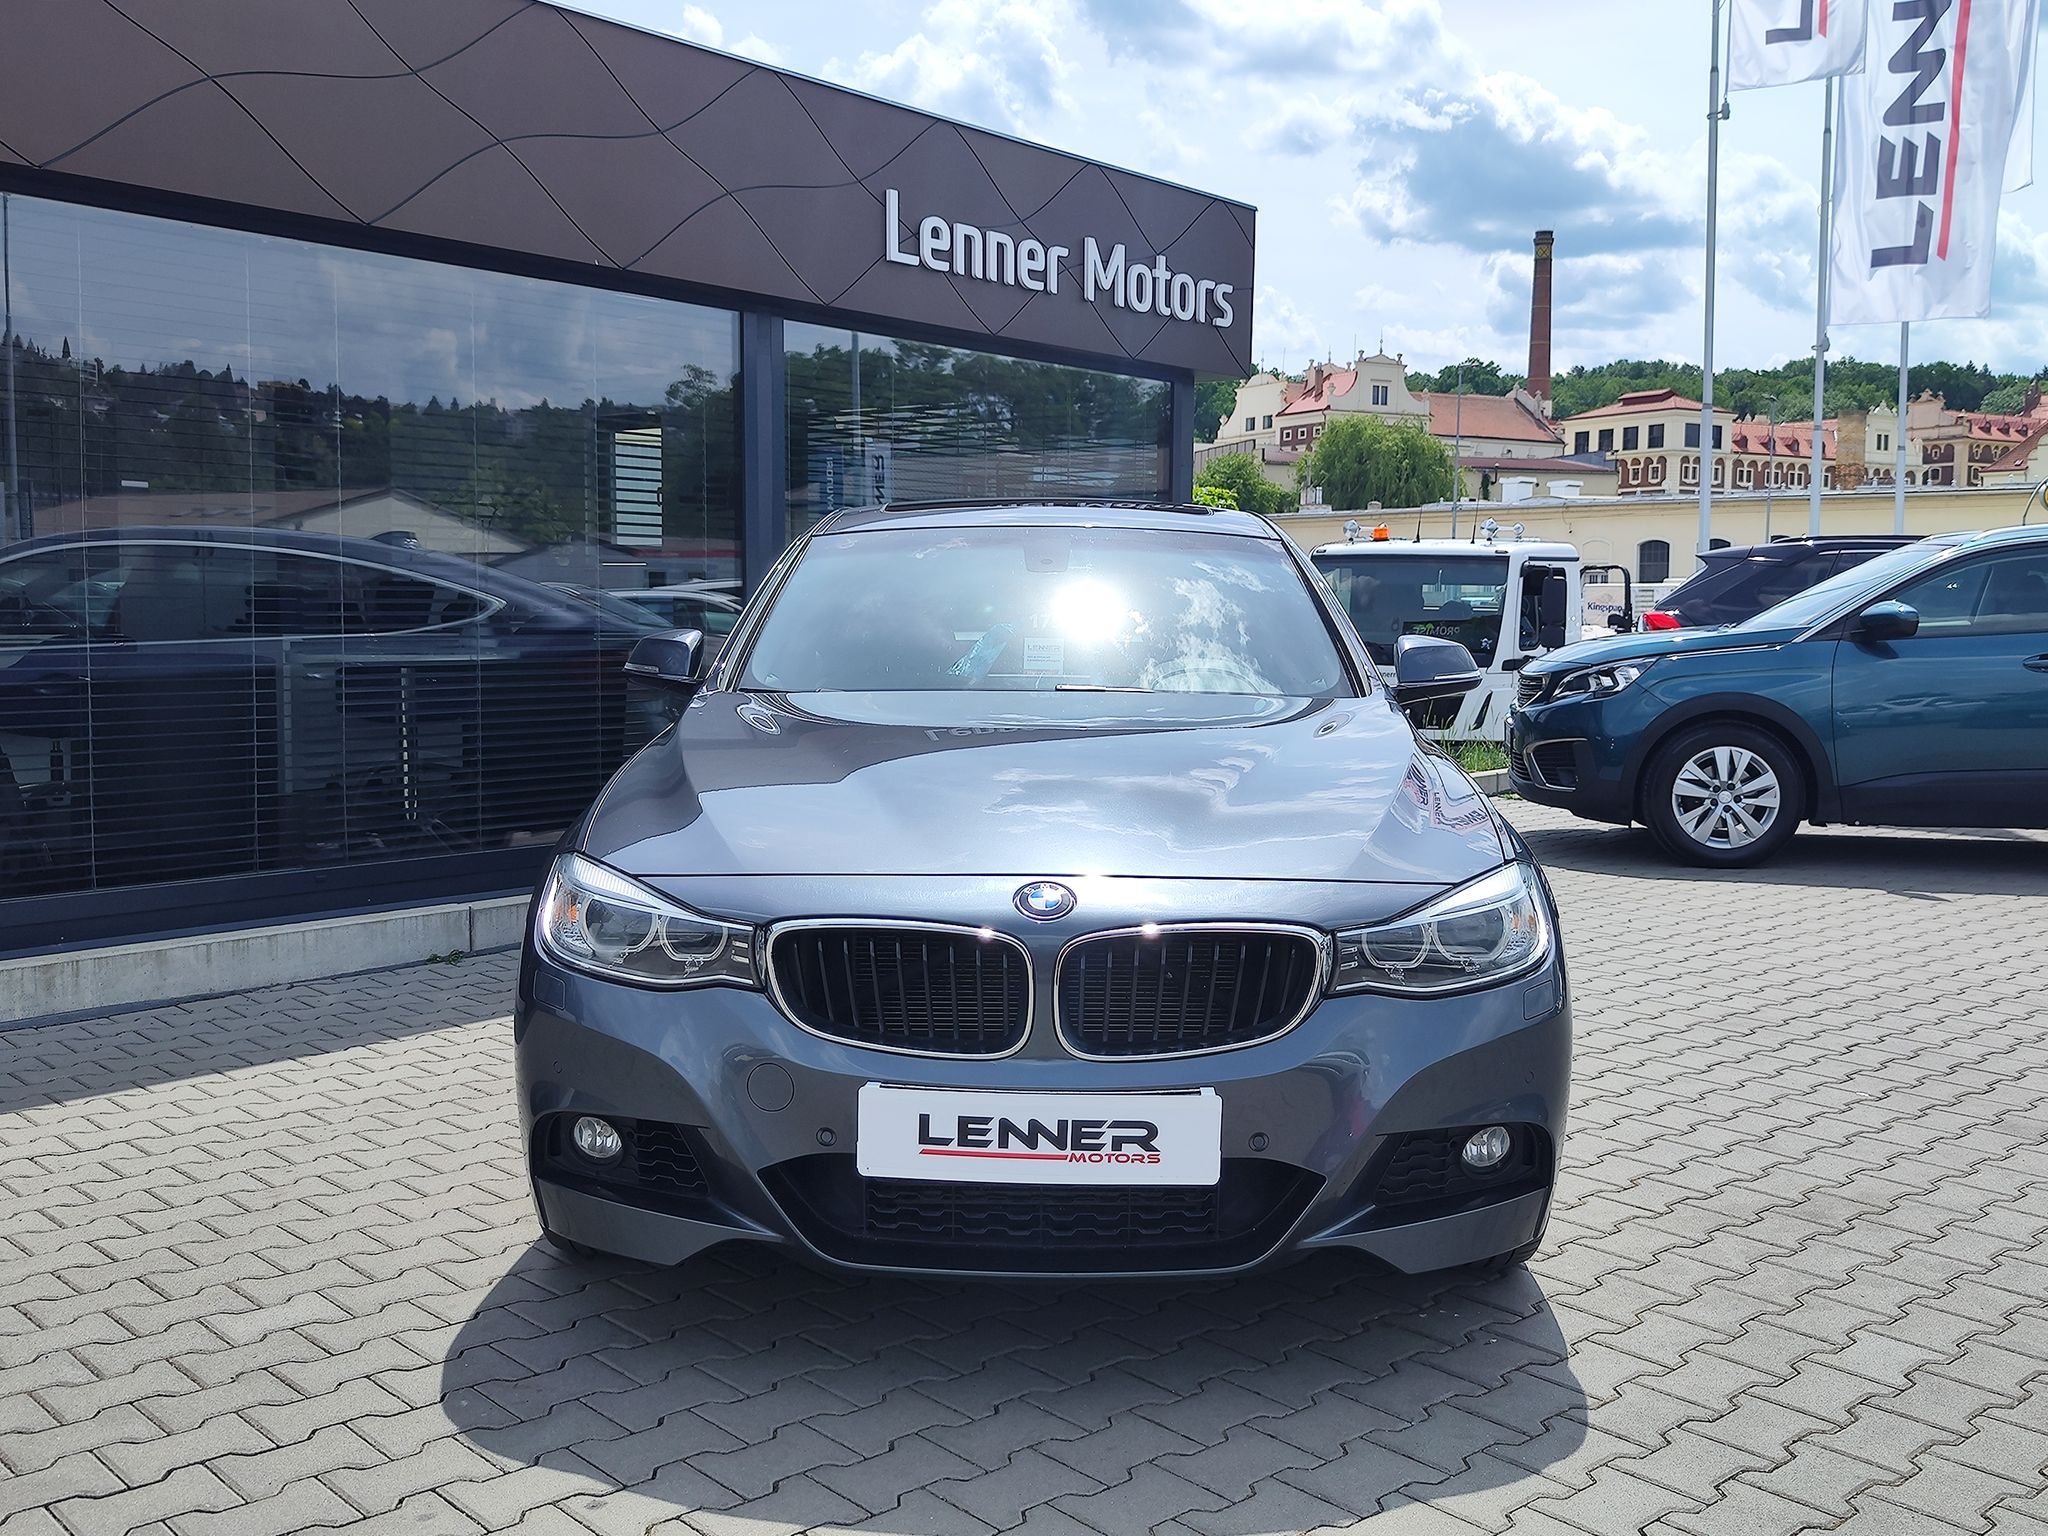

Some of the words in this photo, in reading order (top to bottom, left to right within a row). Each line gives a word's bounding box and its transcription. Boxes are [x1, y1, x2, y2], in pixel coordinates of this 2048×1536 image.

[885, 188, 1069, 295] Lenner
[1083, 236, 1234, 328] Motors
[917, 1113, 1161, 1152] LENNER
[1068, 1152, 1161, 1164] MOTORS
